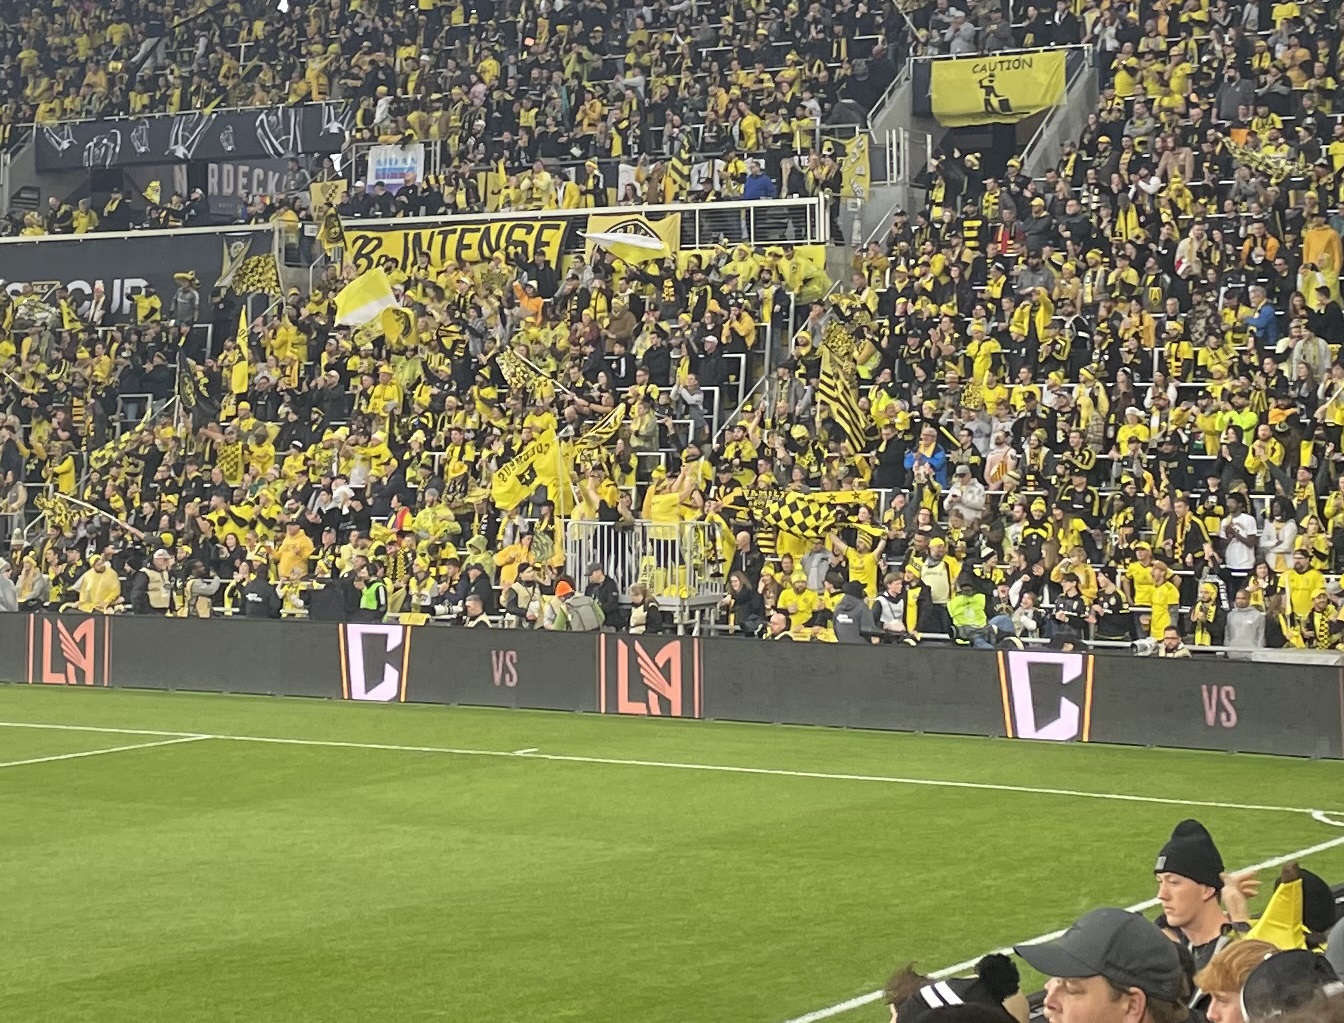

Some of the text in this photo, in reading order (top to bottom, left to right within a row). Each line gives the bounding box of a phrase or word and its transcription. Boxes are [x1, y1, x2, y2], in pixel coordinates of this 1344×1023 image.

[972, 57, 1033, 75] CAUTION
[402, 222, 561, 270] INTENSE
[66, 278, 150, 316] CUP
[491, 649, 518, 688] VS
[1201, 683, 1238, 730] VS
